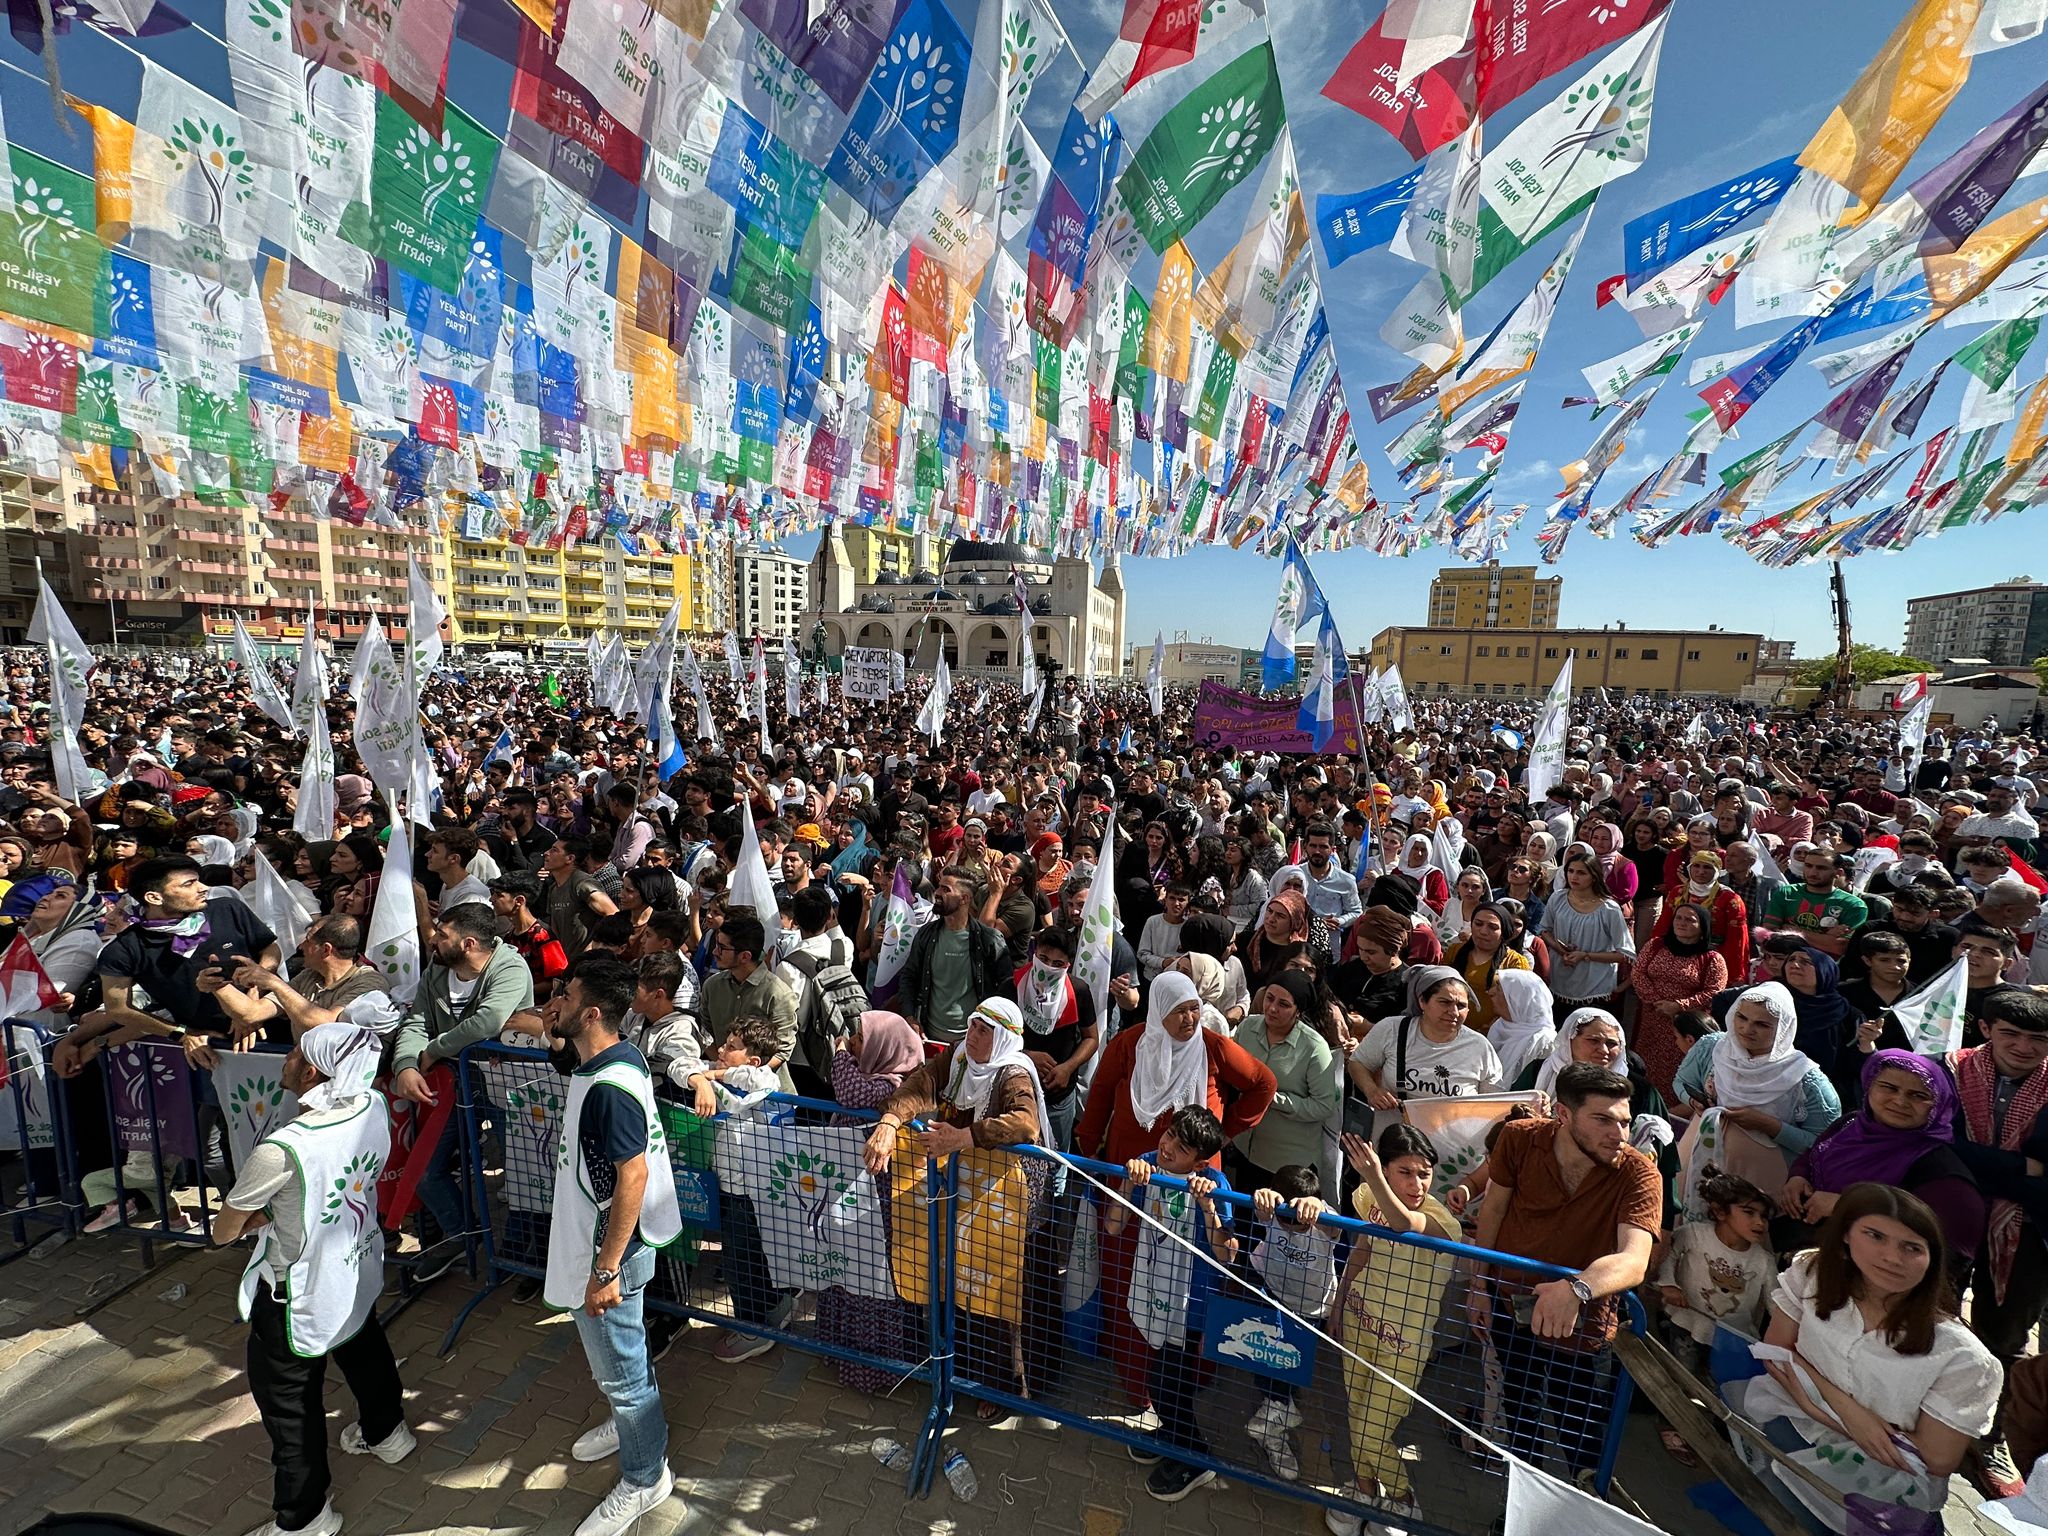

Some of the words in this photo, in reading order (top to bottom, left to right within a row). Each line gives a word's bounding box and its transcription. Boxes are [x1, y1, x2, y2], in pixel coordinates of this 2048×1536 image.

[618, 25, 639, 62] YEŞİL
[613, 61, 648, 98] PARTİ
[752, 67, 799, 113] PARTİ
[845, 127, 871, 162] YEŞİL
[869, 154, 889, 178] SOL
[737, 150, 759, 182] YEŞİL
[759, 174, 782, 199] SOL
[843, 157, 874, 186] PARTİ
[737, 180, 765, 210] PARTİ
[1961, 181, 1996, 214] YEŞİL
[928, 226, 956, 254] PARTİ
[931, 206, 954, 234] YEŞİL
[952, 225, 970, 247] SOL
[1657, 219, 1670, 245] YEŞİL
[1640, 237, 1653, 263] PARTİ
[824, 253, 854, 281] PARTİ
[374, 293, 389, 308] SO
[1653, 279, 1670, 299] YEŞİL
[438, 299, 460, 321] YEŞİL
[459, 307, 480, 326] SOL
[444, 319, 468, 335] PARTİ
[269, 381, 294, 396] YEŞİL
[294, 387, 311, 399] SOL
[279, 393, 304, 407] PARTİ
[845, 665, 859, 678] NE
[862, 667, 889, 681] DERSE
[851, 681, 880, 696] ODUR
[1253, 1350, 1299, 1369] DİYESİ
